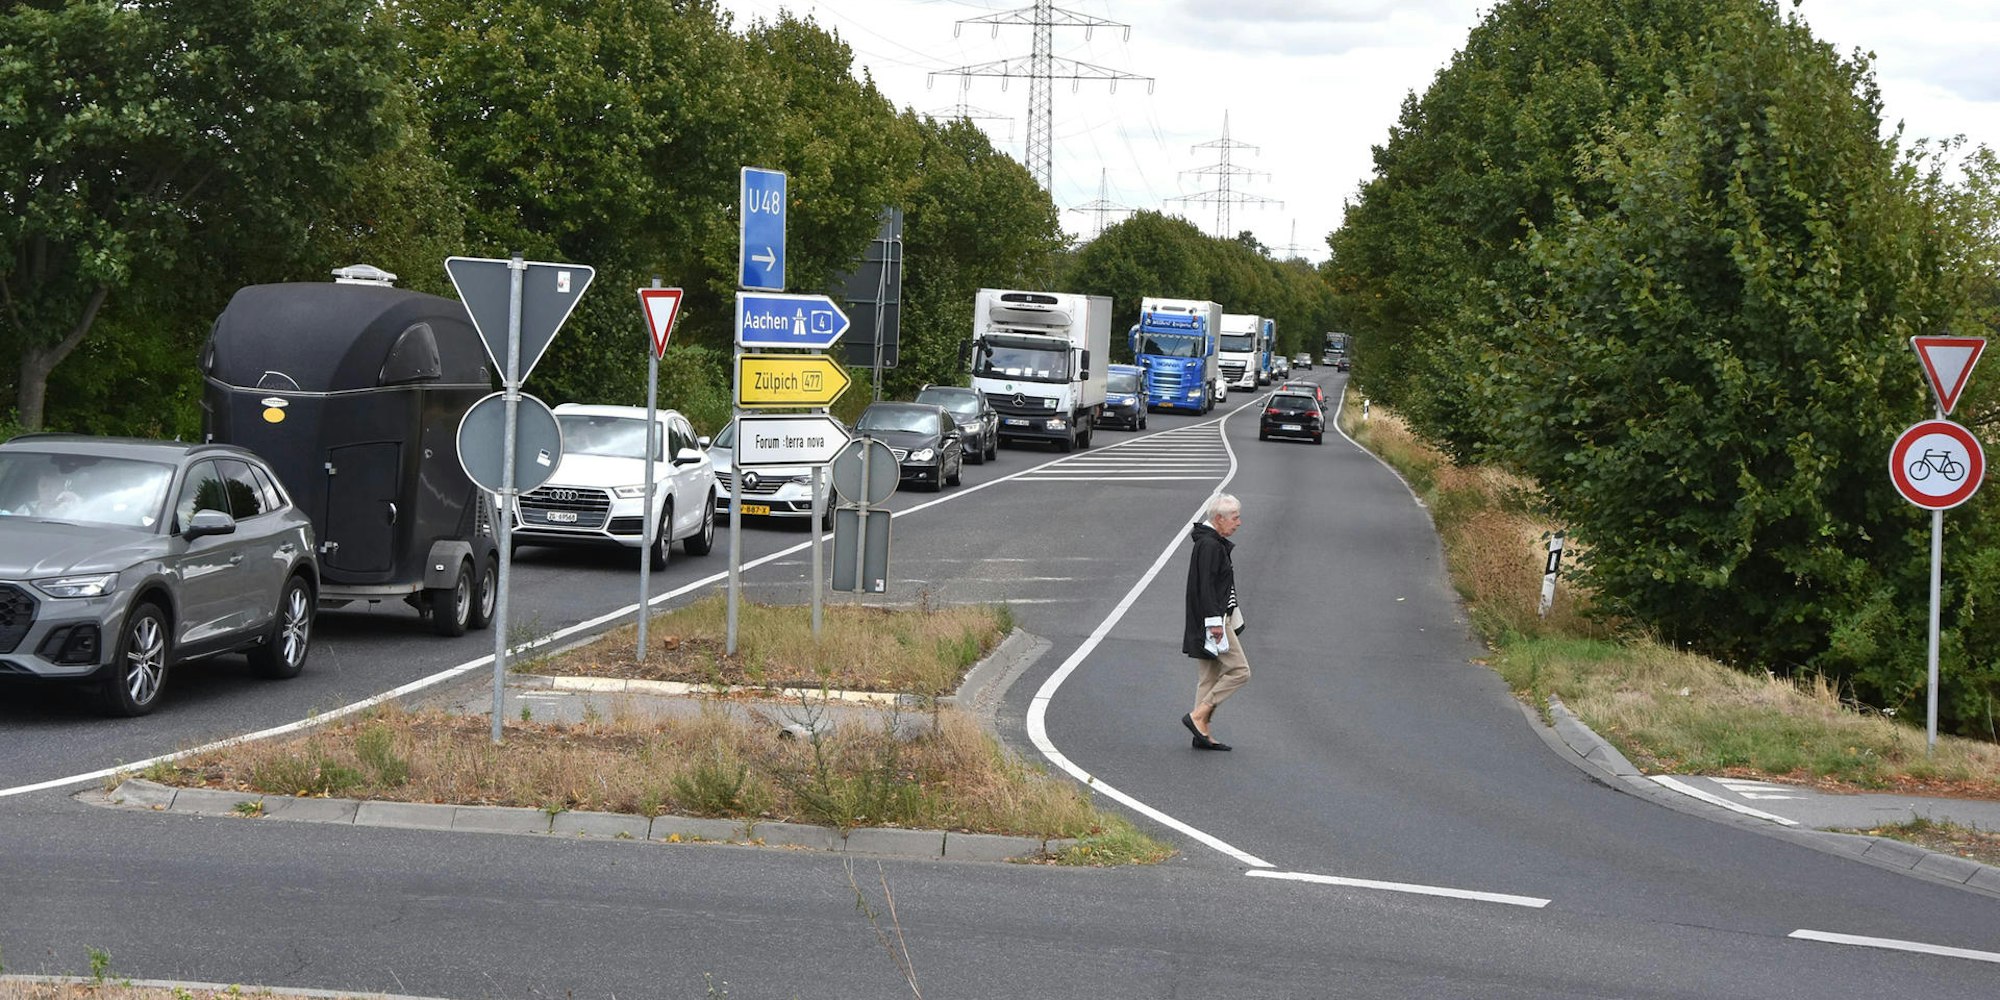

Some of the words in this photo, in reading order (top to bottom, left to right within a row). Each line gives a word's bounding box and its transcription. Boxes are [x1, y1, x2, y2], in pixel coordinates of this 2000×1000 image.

[744, 310, 788, 330] Aachen
[819, 315, 825, 329] 4
[755, 372, 798, 394] Zülpich
[804, 374, 820, 388] 477
[755, 434, 780, 449] Forum
[807, 436, 825, 449] nova
